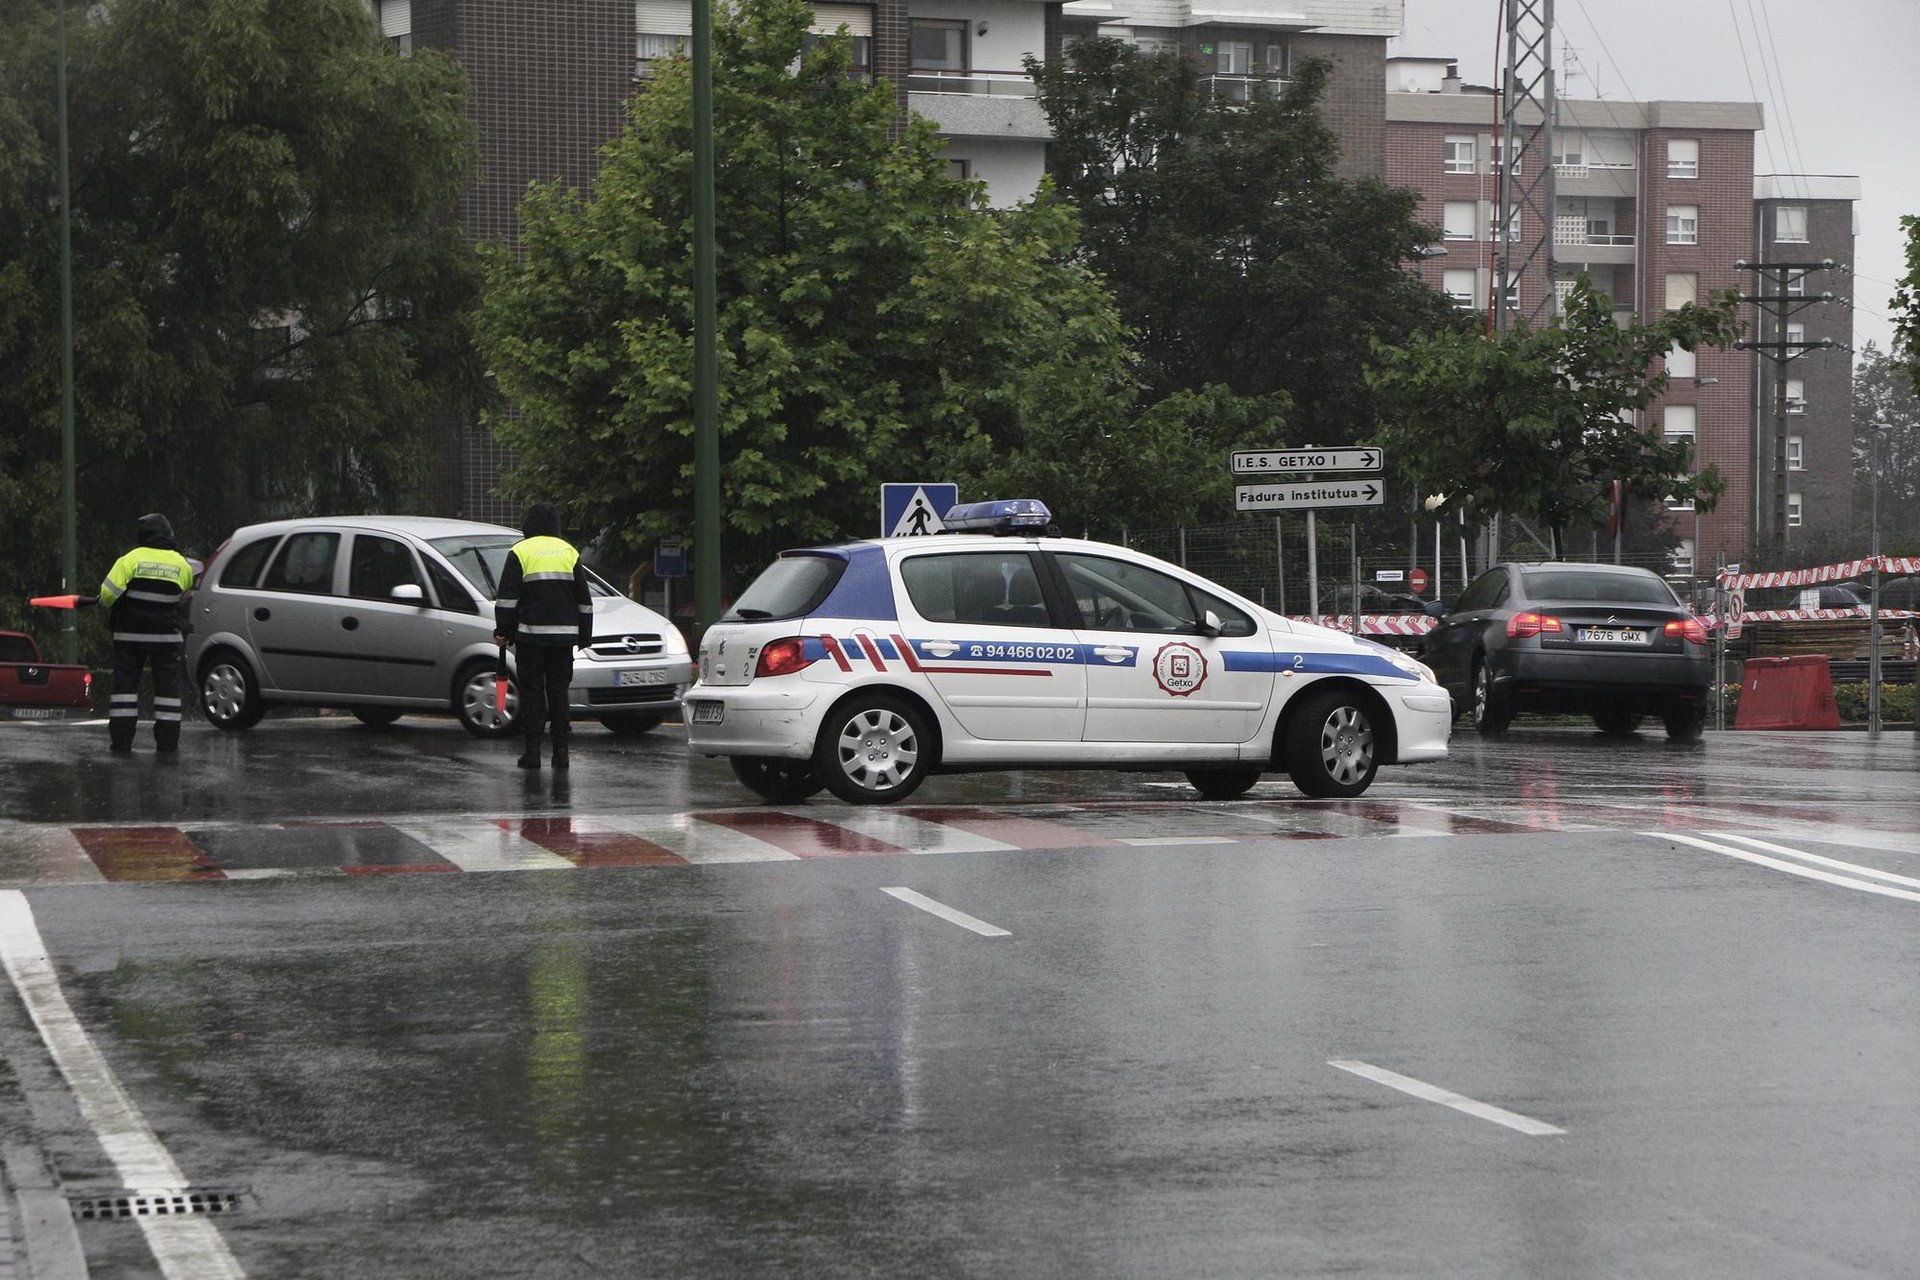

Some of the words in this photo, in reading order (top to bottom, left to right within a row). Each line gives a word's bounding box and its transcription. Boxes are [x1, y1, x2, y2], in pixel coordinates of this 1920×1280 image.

[1238, 457, 1271, 468] I.E.S.
[1279, 456, 1325, 467] GETXO
[1332, 455, 1336, 465] I
[1240, 492, 1285, 503] Fadura
[1291, 488, 1358, 501] institutua
[1587, 630, 1614, 641] 7676
[1621, 631, 1641, 642] GMX
[986, 645, 1004, 657] 94
[1007, 645, 1034, 658] 466
[1036, 646, 1054, 659] 02
[1057, 647, 1074, 660] 02
[1293, 654, 1304, 669] 2
[743, 662, 750, 677] 2
[1167, 678, 1193, 687] Getxo
